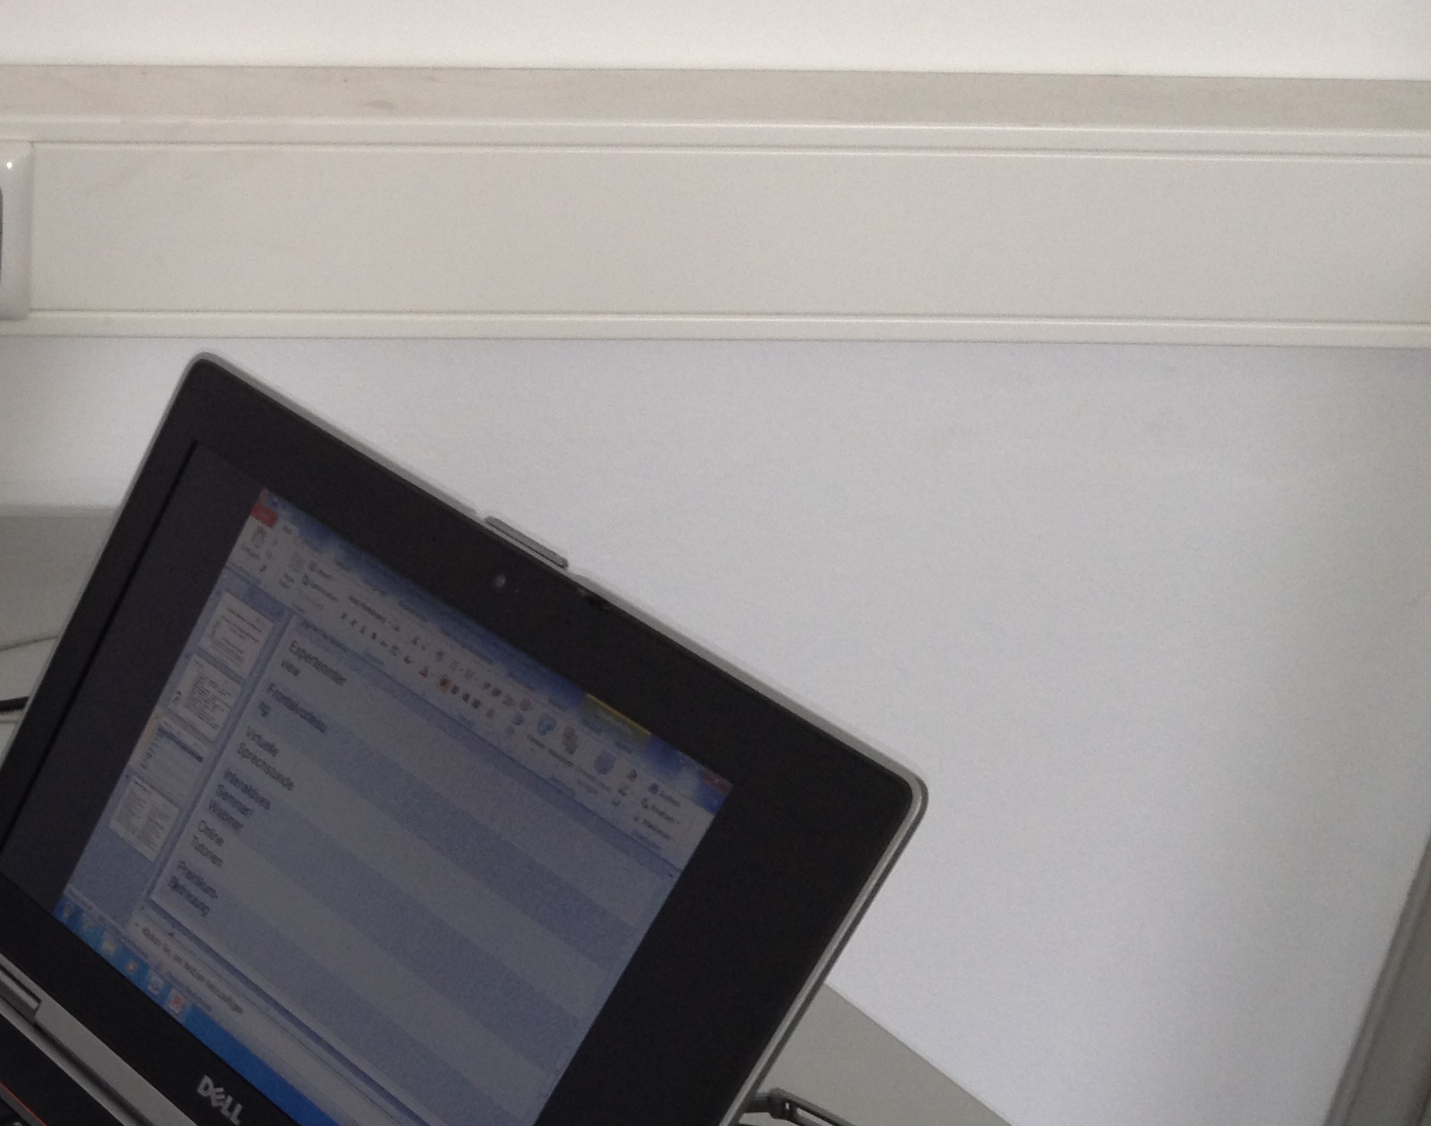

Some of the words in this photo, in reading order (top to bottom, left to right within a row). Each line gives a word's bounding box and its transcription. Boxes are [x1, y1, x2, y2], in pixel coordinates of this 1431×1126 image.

[237, 742, 294, 791] Sprechstunde
[191, 834, 224, 868] Tutorien
[197, 819, 225, 847] Online
[197, 1074, 243, 1126] DELL
